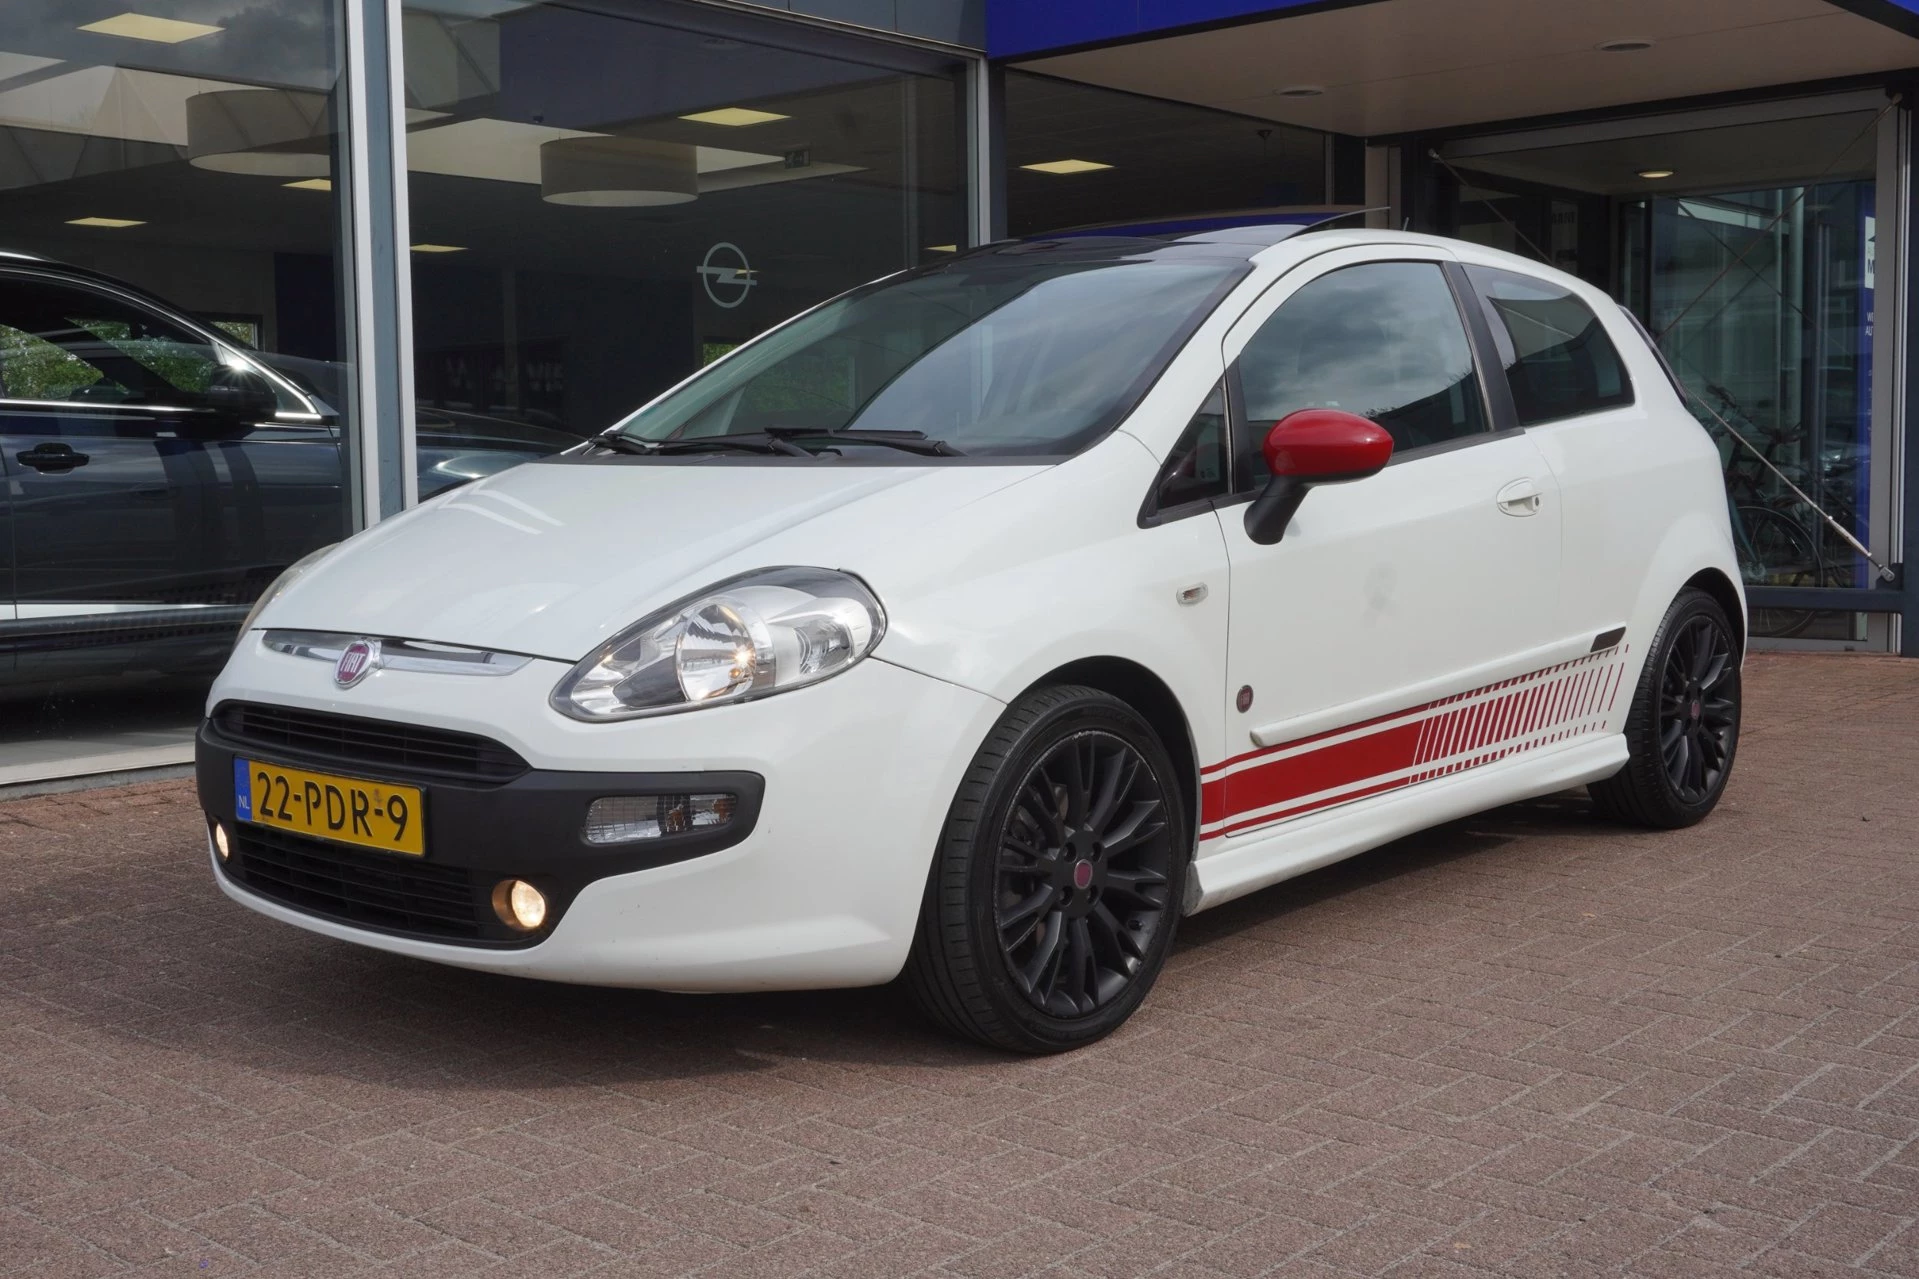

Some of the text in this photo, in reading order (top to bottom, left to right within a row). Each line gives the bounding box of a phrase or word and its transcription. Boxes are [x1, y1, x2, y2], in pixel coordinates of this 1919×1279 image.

[340, 651, 366, 673] FIAT
[238, 795, 251, 810] NL
[257, 771, 408, 841] 22-PDR-9
